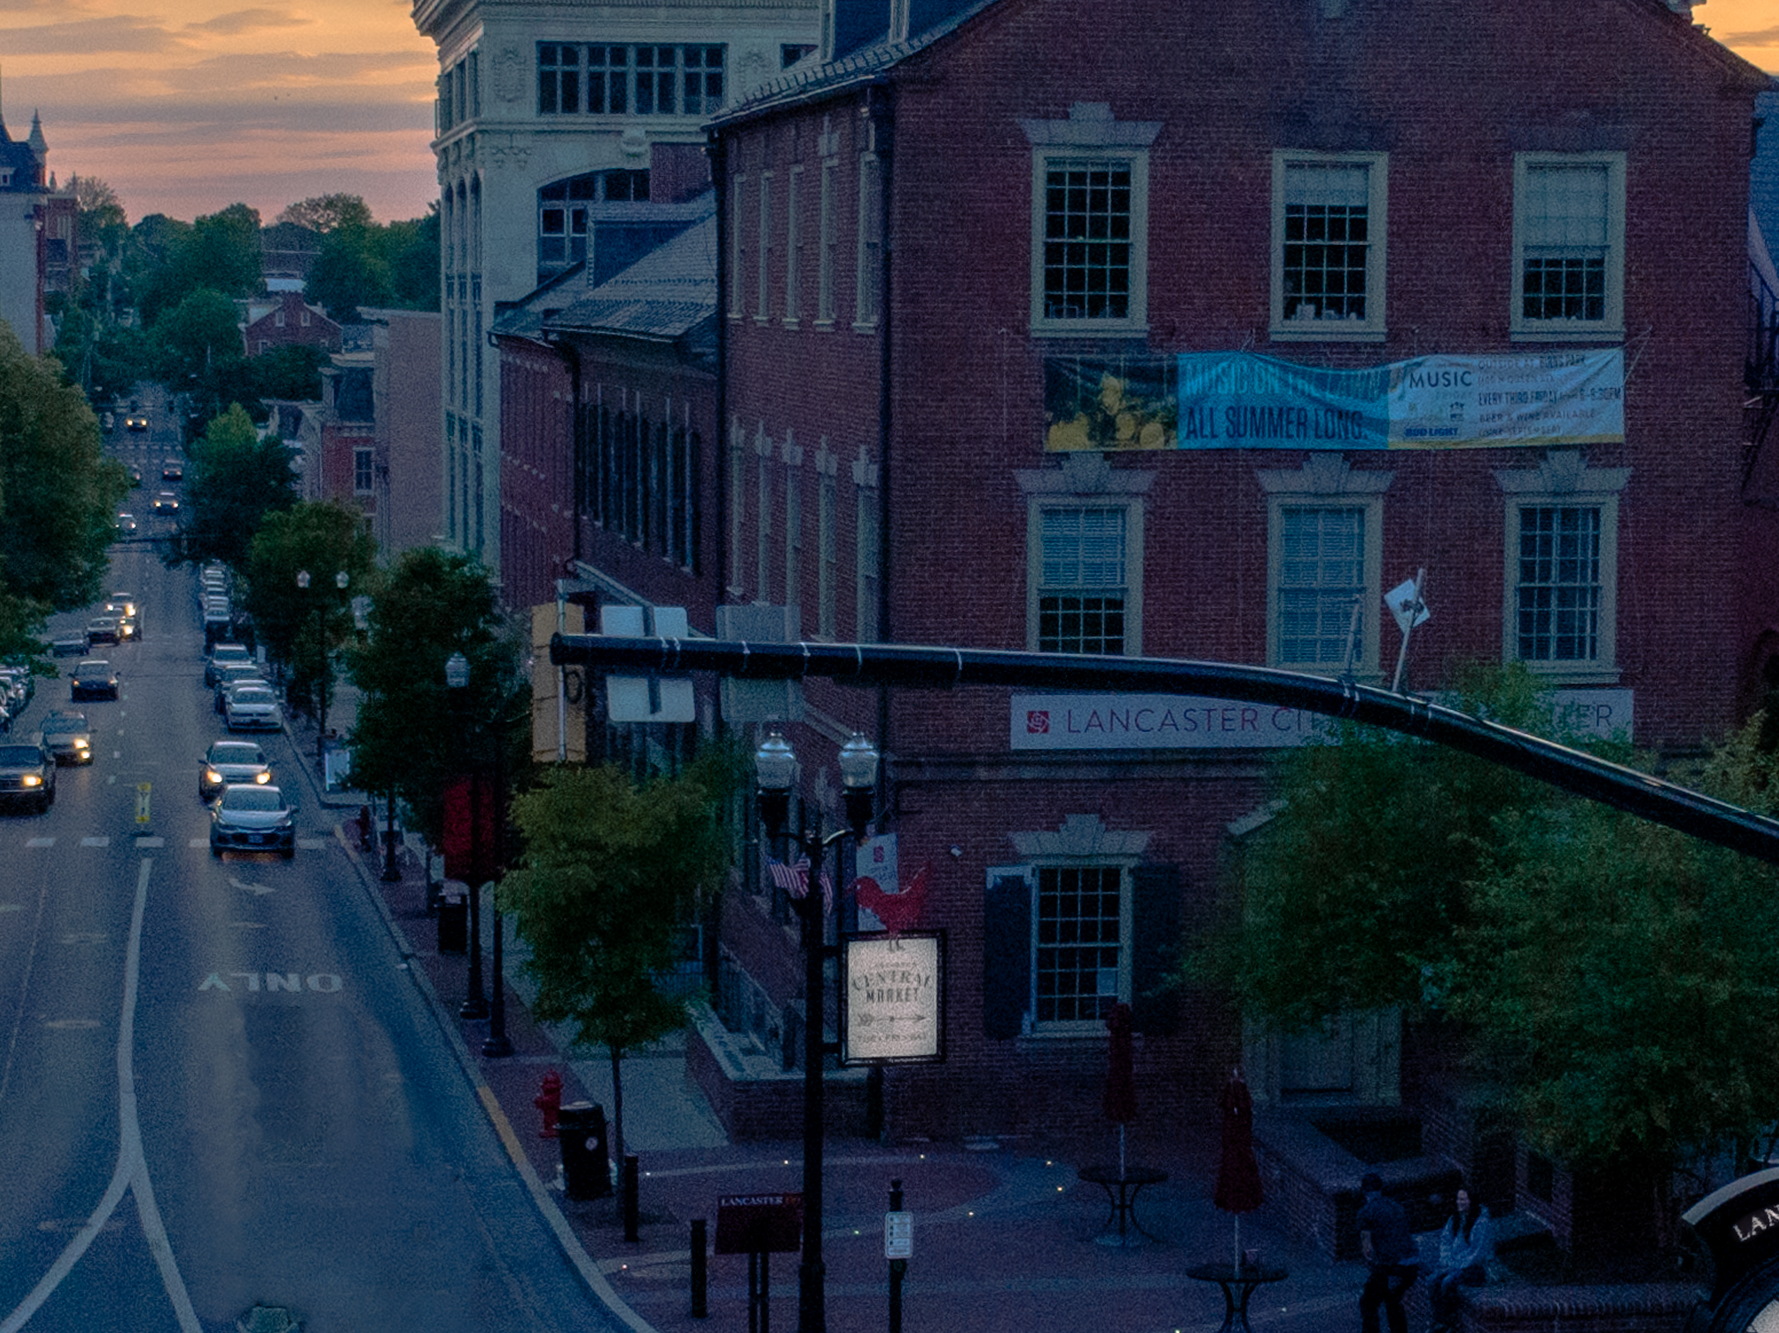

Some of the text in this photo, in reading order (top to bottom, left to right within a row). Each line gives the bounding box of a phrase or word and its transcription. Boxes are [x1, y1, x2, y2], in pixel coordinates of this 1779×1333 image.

[1409, 370, 1472, 389] MUSIC
[1186, 405, 1369, 441] ALL SUMMER LONG.
[1067, 705, 1259, 734] LANCASTER
[197, 972, 343, 993] ONLY
[852, 969, 931, 991] CENTRAL
[865, 987, 920, 1003] MARKET
